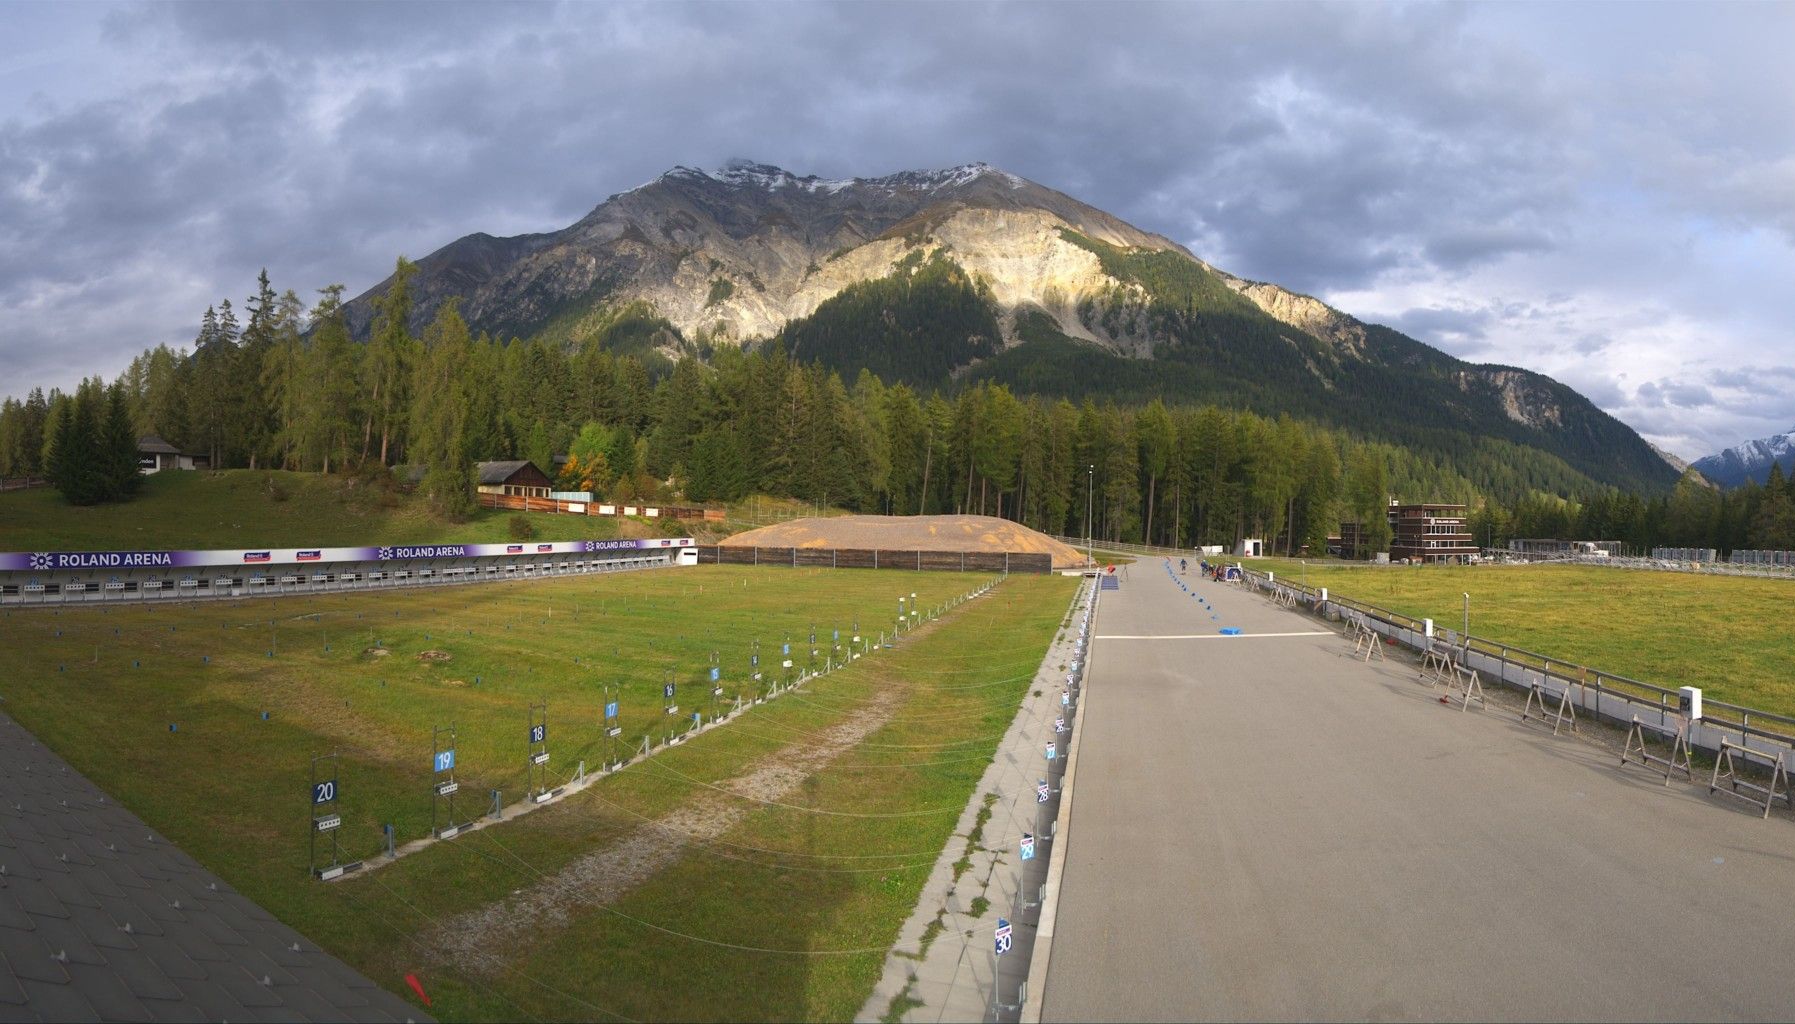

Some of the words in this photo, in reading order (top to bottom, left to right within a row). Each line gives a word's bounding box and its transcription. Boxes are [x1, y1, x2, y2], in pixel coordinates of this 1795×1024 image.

[595, 541, 618, 549] ROLAND
[619, 540, 637, 548] ARENA
[396, 547, 434, 558] ROLAND
[436, 546, 465, 556] ARENA
[59, 554, 120, 566] ROLAND
[124, 553, 171, 565] ARENA
[666, 683, 673, 697] 16
[607, 702, 616, 714] 17
[532, 726, 543, 742] 18
[438, 751, 451, 769] 19
[317, 781, 334, 803] 20
[1038, 790, 1049, 803] 28
[1021, 844, 1034, 860] 29
[996, 934, 1012, 954] 30
